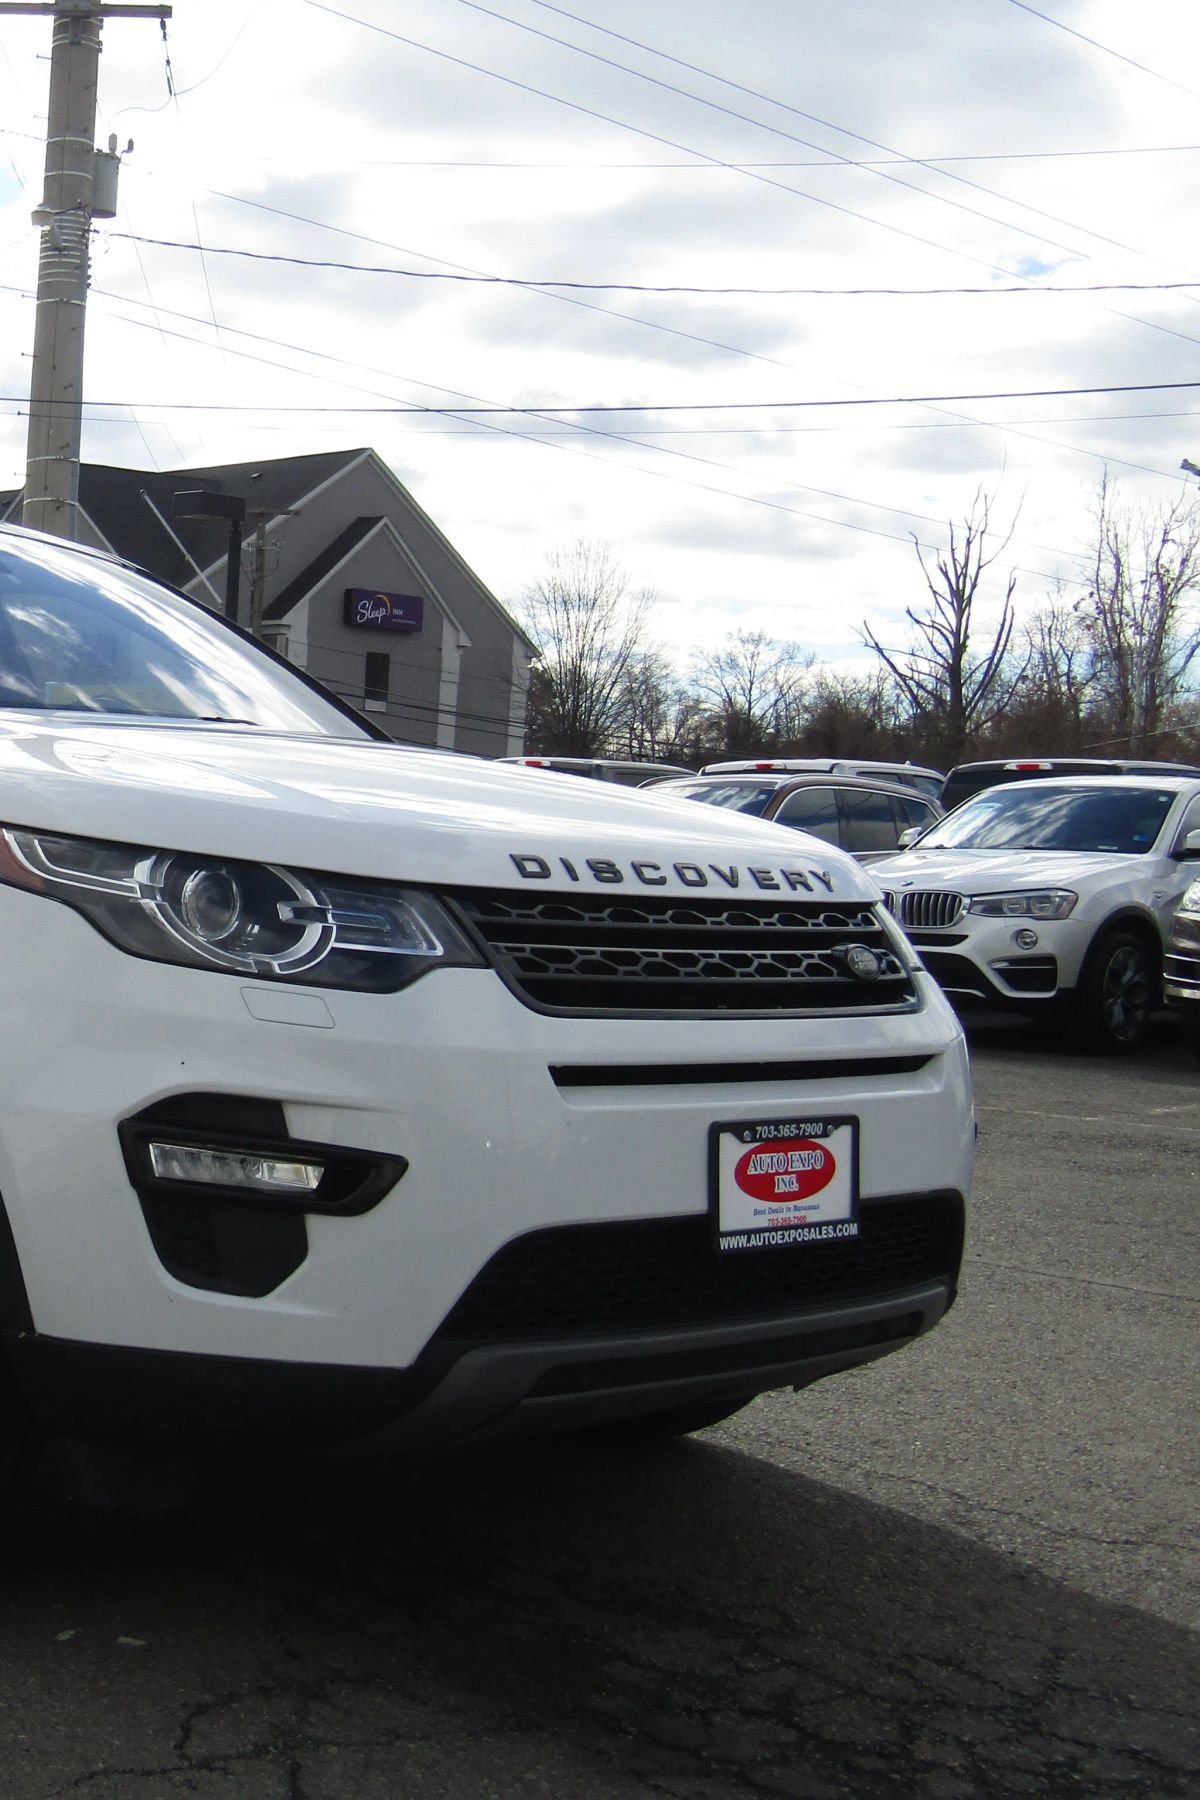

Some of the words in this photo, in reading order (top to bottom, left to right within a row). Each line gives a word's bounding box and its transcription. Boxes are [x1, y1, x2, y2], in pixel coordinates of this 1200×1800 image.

[357, 600, 387, 624] Sleep
[509, 853, 834, 893] DISCOVERY
[755, 1122, 823, 1139] 703-365-7900
[748, 1152, 787, 1174] AUTO
[788, 1150, 824, 1172] EXPO
[775, 1174, 799, 1193] INC.
[753, 1207, 767, 1217] Best
[767, 1205, 785, 1215] Deals
[767, 1215, 807, 1227] 703-365-7900
[720, 1223, 858, 1250] WWW.AUTOEXPOSALES.COM
